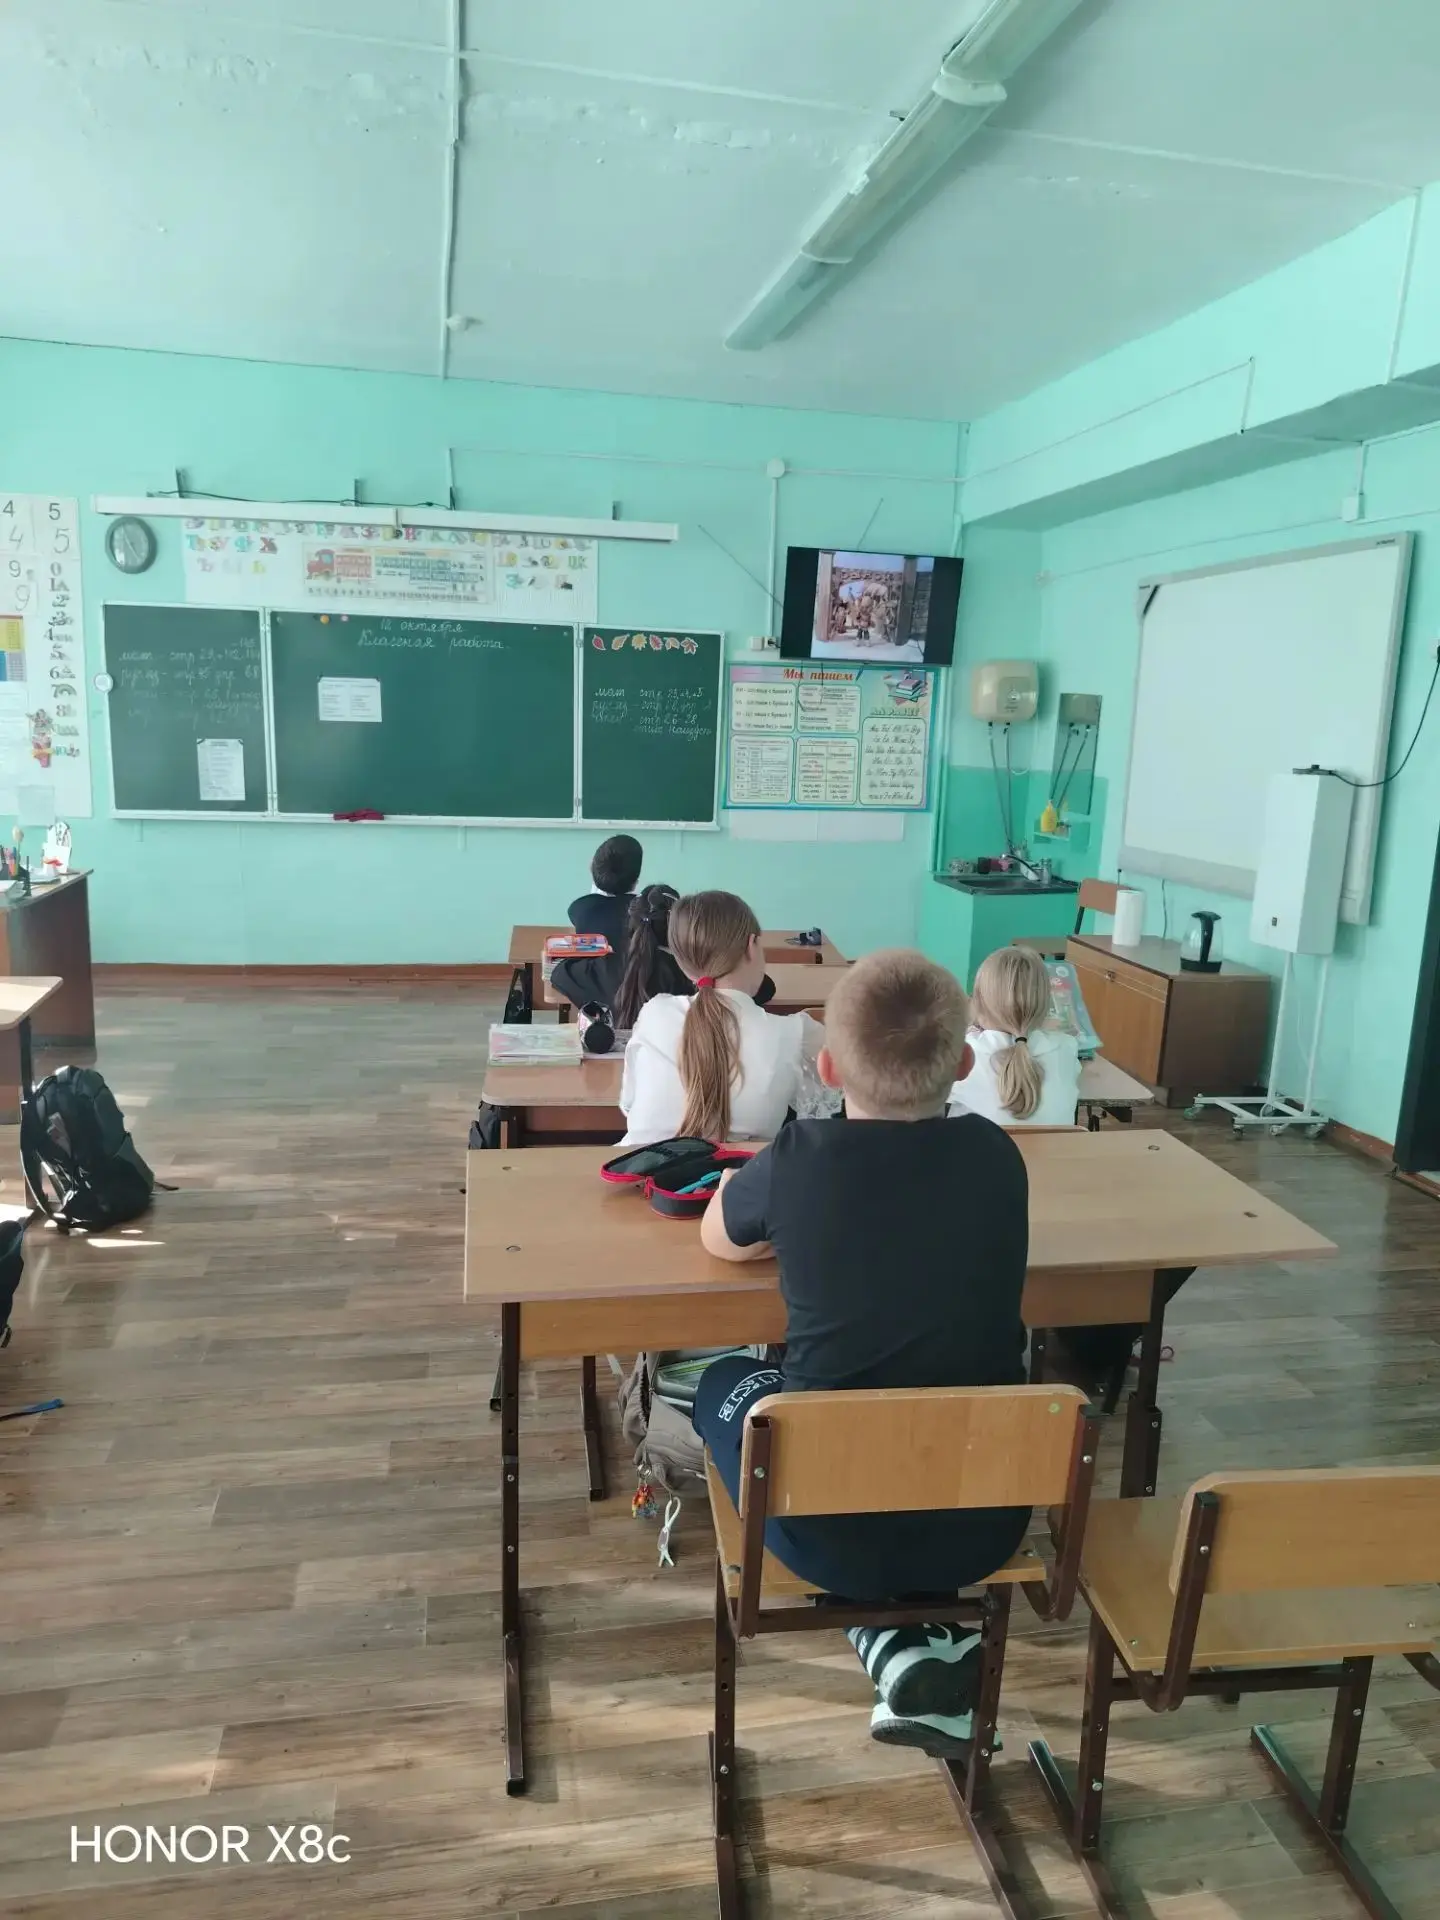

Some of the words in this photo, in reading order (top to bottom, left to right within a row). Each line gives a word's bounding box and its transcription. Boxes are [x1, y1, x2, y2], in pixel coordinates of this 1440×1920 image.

[2, 500, 15, 518] 4
[48, 502, 61, 521] 5
[9, 524, 24, 551] 4
[54, 528, 70, 554] 5
[8, 559, 21, 578] 9
[15, 584, 31, 612] 9
[784, 667, 804, 679] Мы
[810, 671, 853, 682] пишем
